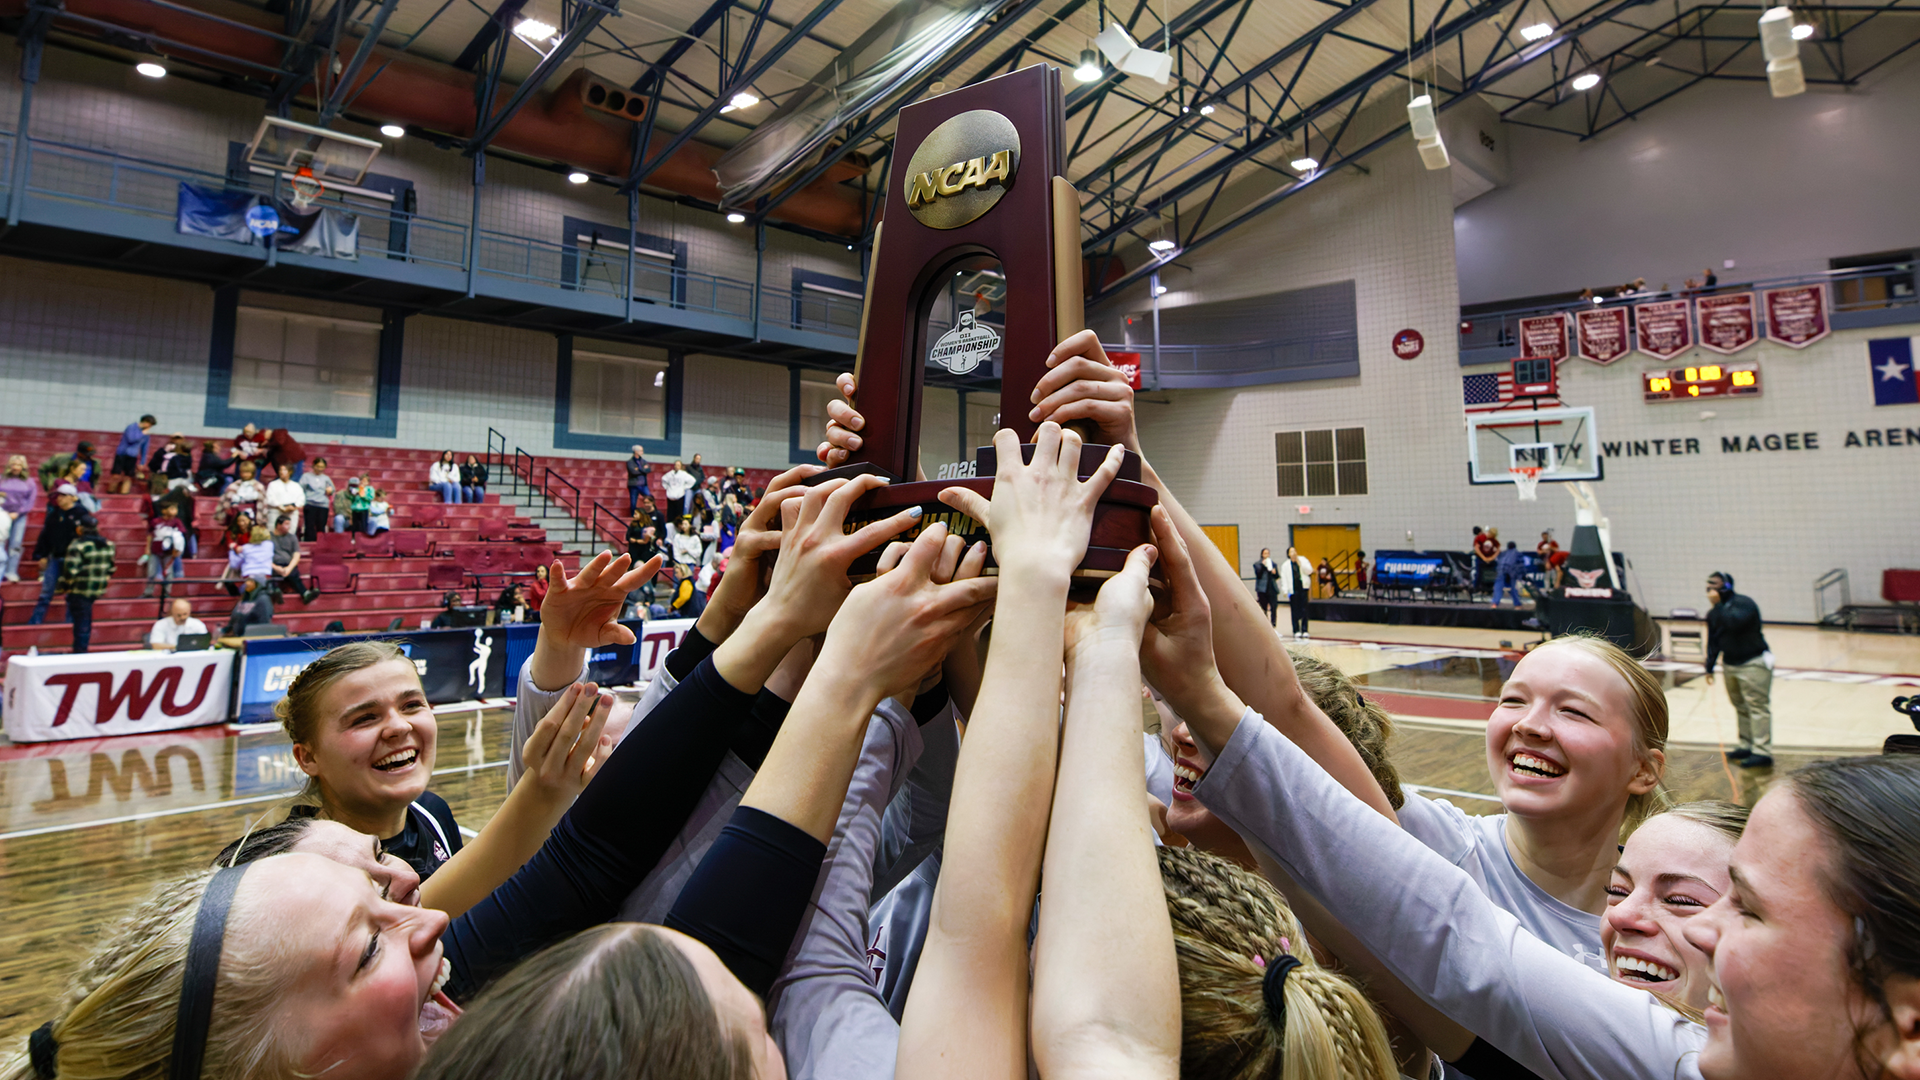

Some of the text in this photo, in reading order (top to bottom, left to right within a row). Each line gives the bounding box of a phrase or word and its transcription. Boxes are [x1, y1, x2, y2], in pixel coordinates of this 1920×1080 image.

[908, 150, 1012, 208] NCAA
[250, 219, 278, 230] NCAA
[932, 338, 998, 359] CHAMPIONSHIP
[962, 335, 991, 344] BASKETBALL
[1602, 438, 1700, 458] WINTER
[1721, 432, 1819, 453] MAGEE
[937, 460, 977, 480] 2026
[44, 663, 217, 727] TWU
